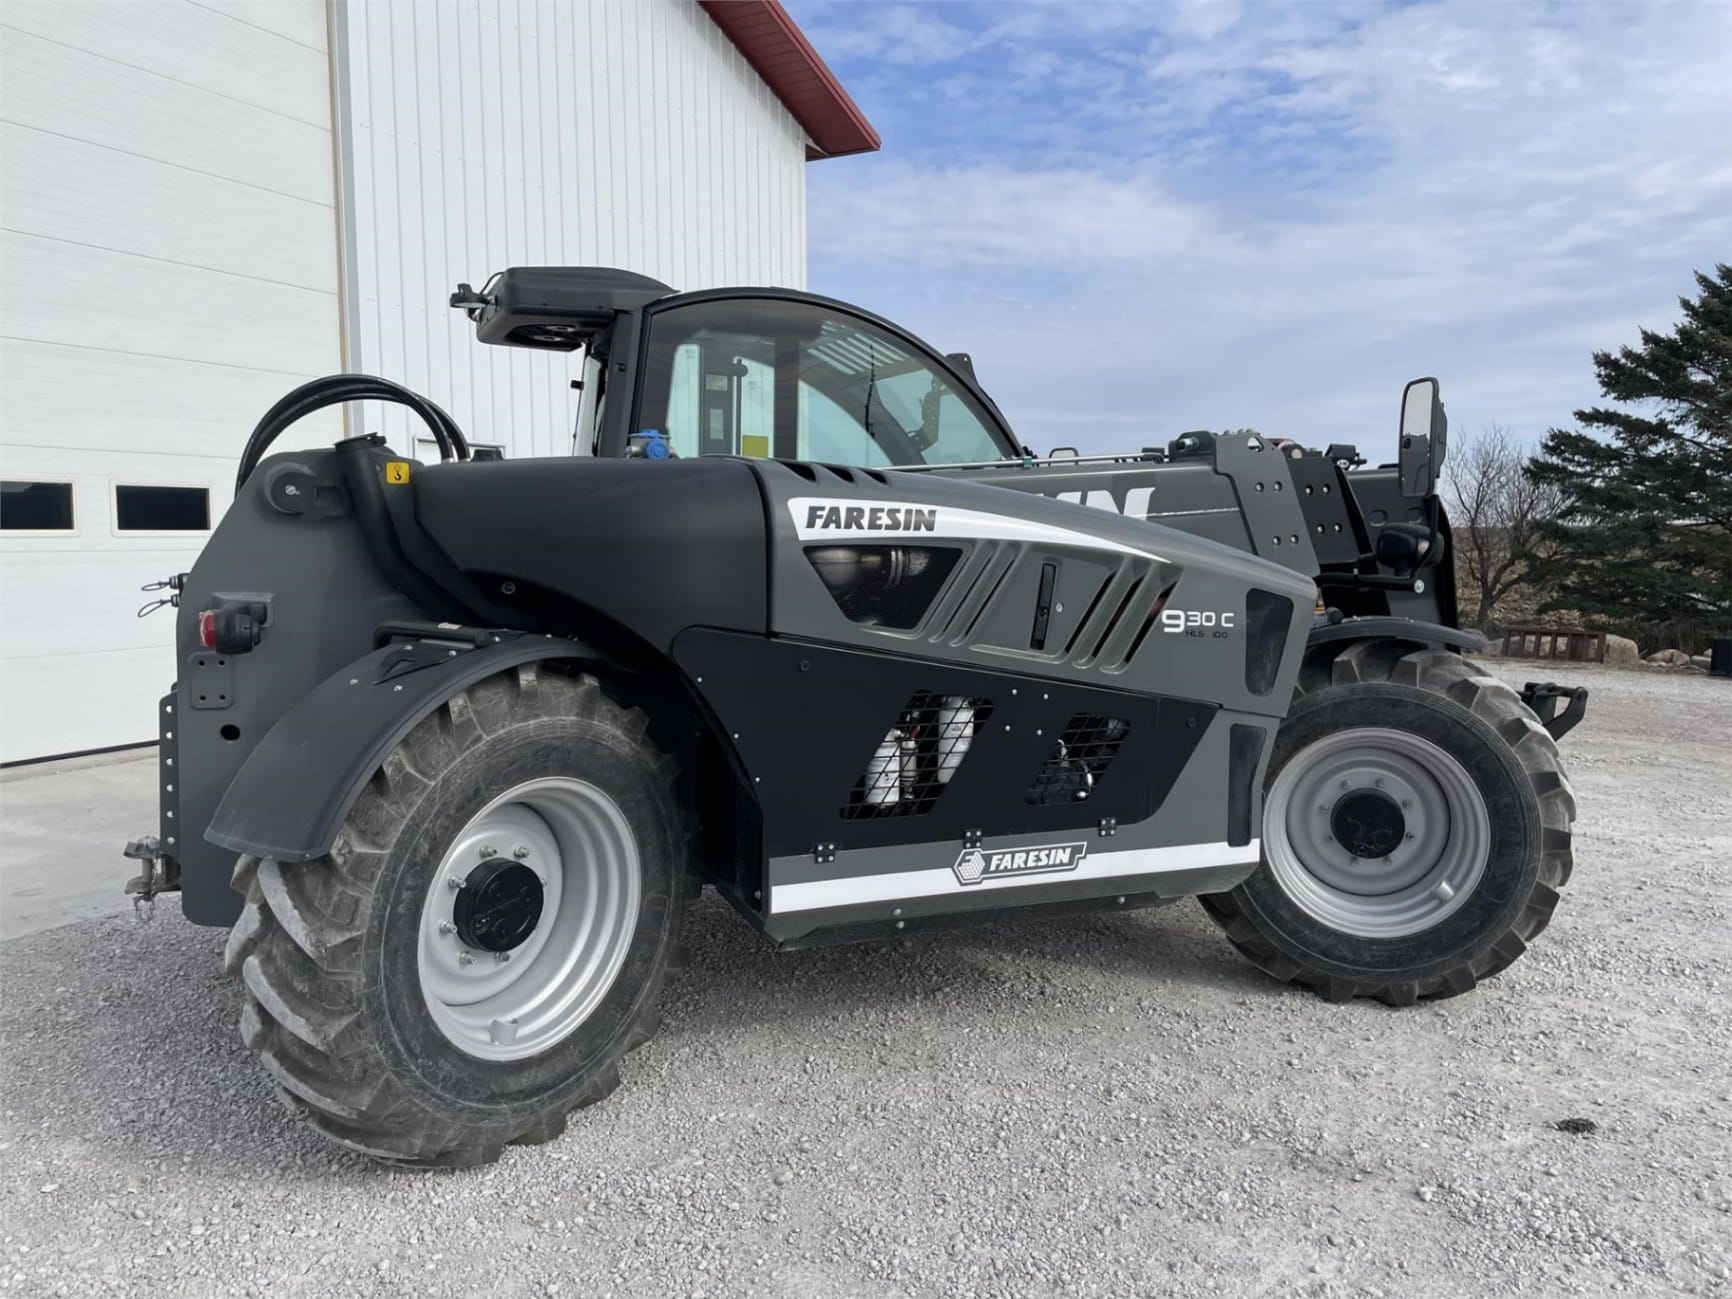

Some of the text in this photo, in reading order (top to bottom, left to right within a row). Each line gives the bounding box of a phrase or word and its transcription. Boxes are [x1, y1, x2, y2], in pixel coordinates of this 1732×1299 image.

[805, 506, 937, 531] FARESIN
[1162, 609, 1234, 632] 930 C
[1185, 629, 1205, 637] HLS
[989, 848, 1072, 871] FARESIN
